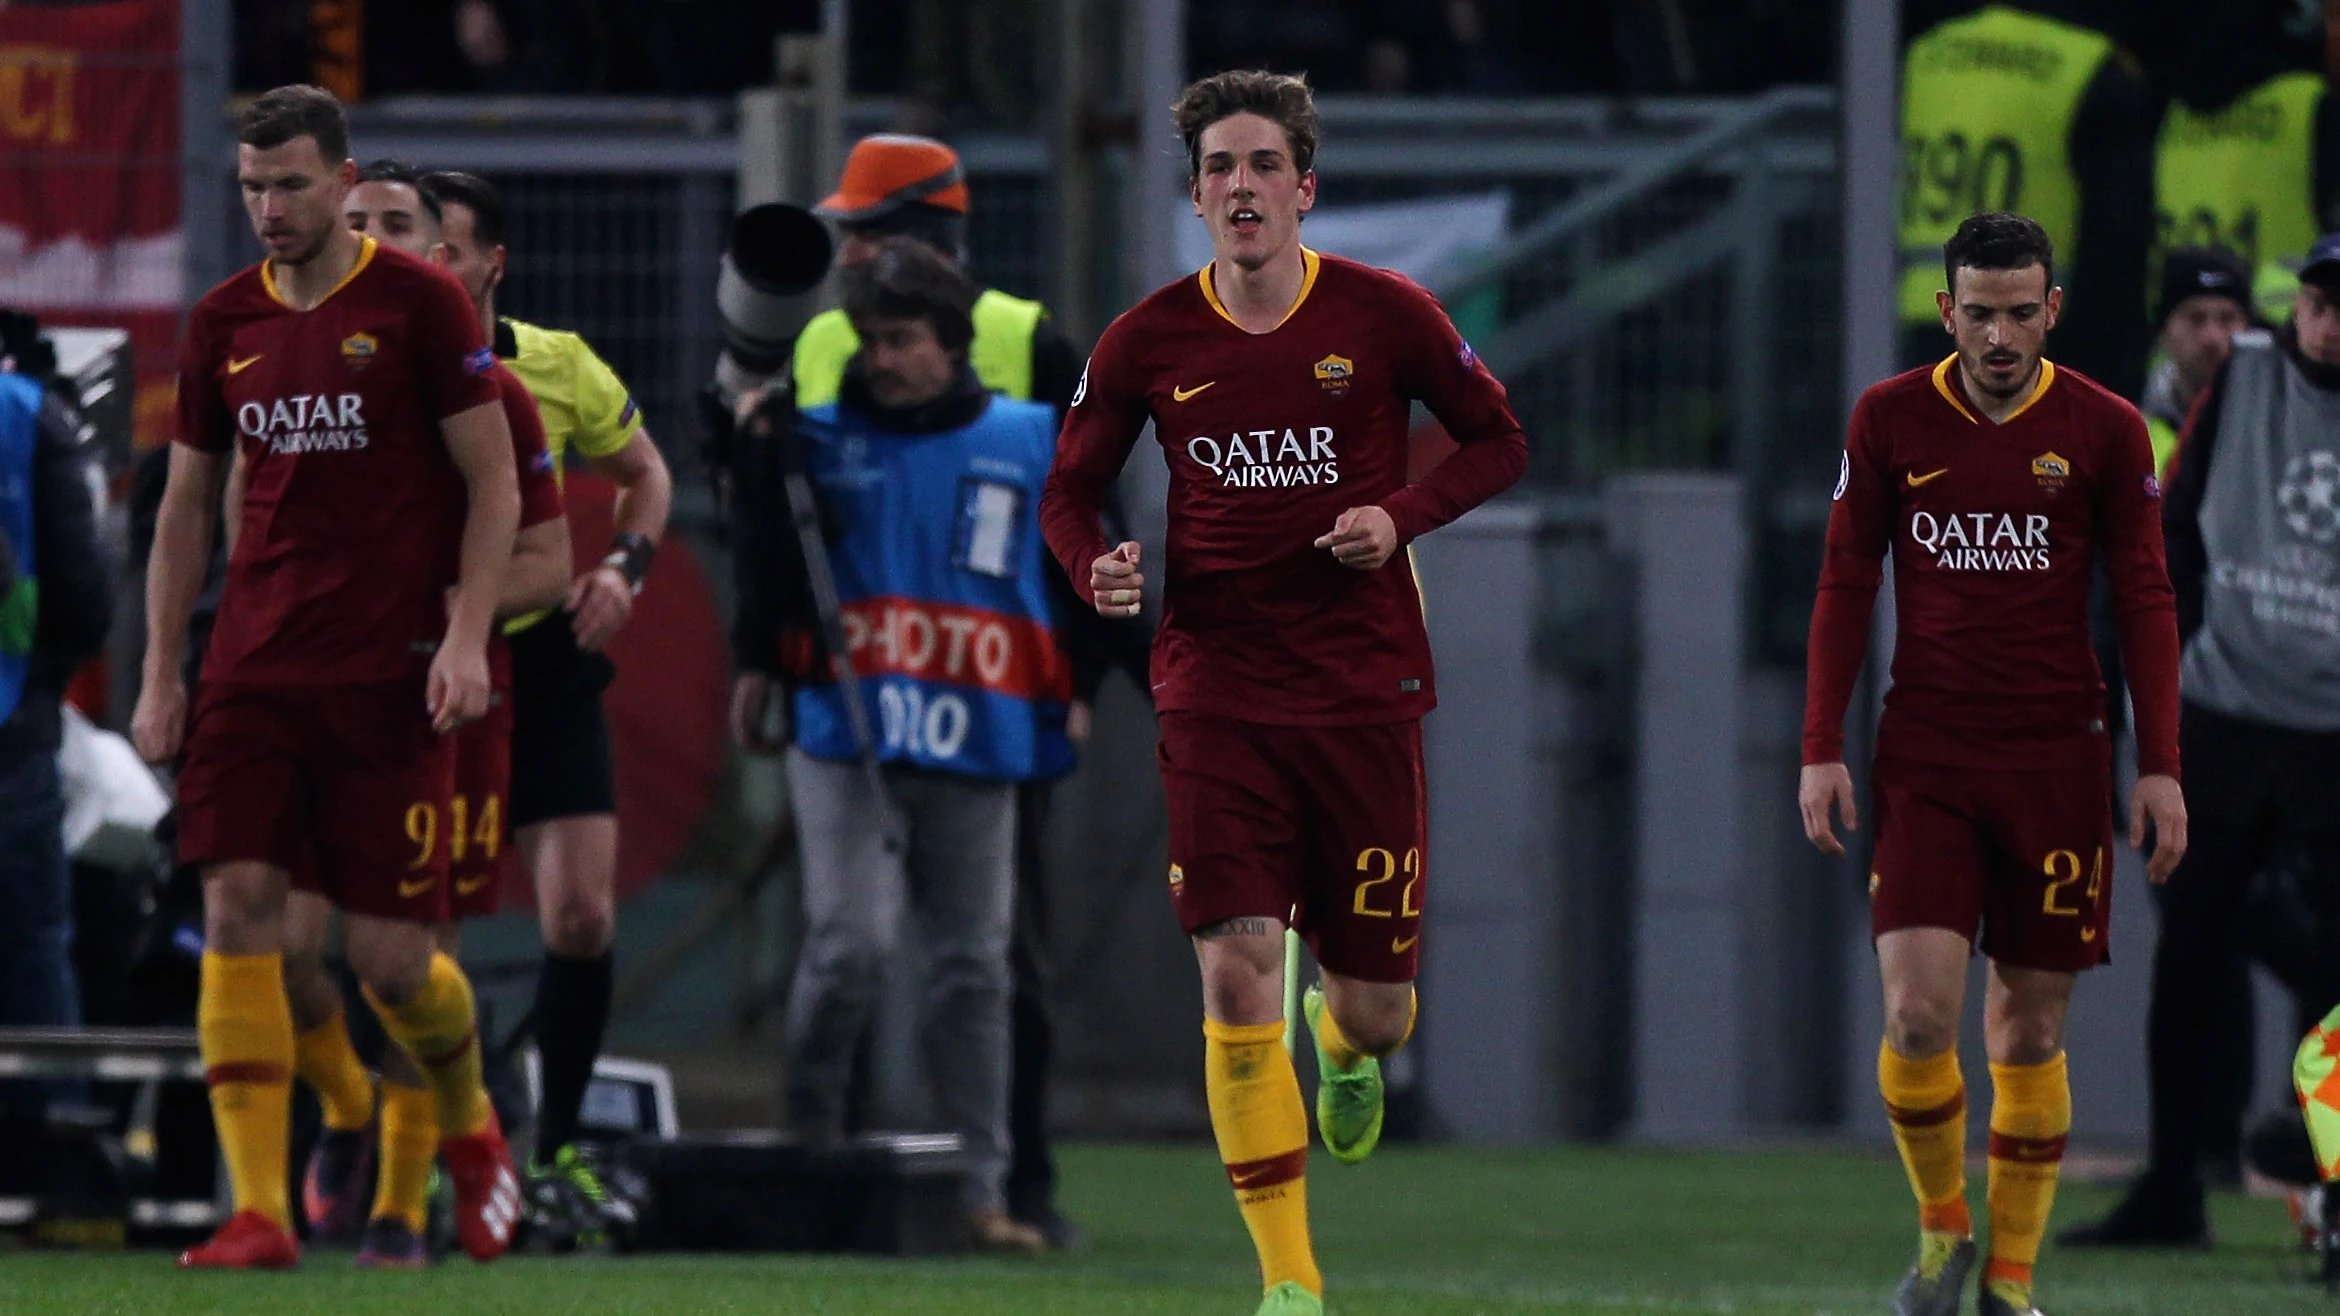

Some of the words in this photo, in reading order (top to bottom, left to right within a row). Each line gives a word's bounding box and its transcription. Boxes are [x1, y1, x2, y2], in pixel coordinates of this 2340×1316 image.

[238, 392, 367, 442] QATAR
[269, 428, 370, 454] AIRWAYS
[1187, 426, 1337, 476] QATAR
[1223, 462, 1339, 487] AIRWAYS
[1911, 511, 2050, 554] QATAR
[1936, 548, 2051, 571] AIRWAYS
[403, 801, 438, 872] 9
[450, 793, 501, 862] 14
[1352, 846, 1420, 919] 22
[2042, 845, 2104, 917] 24
